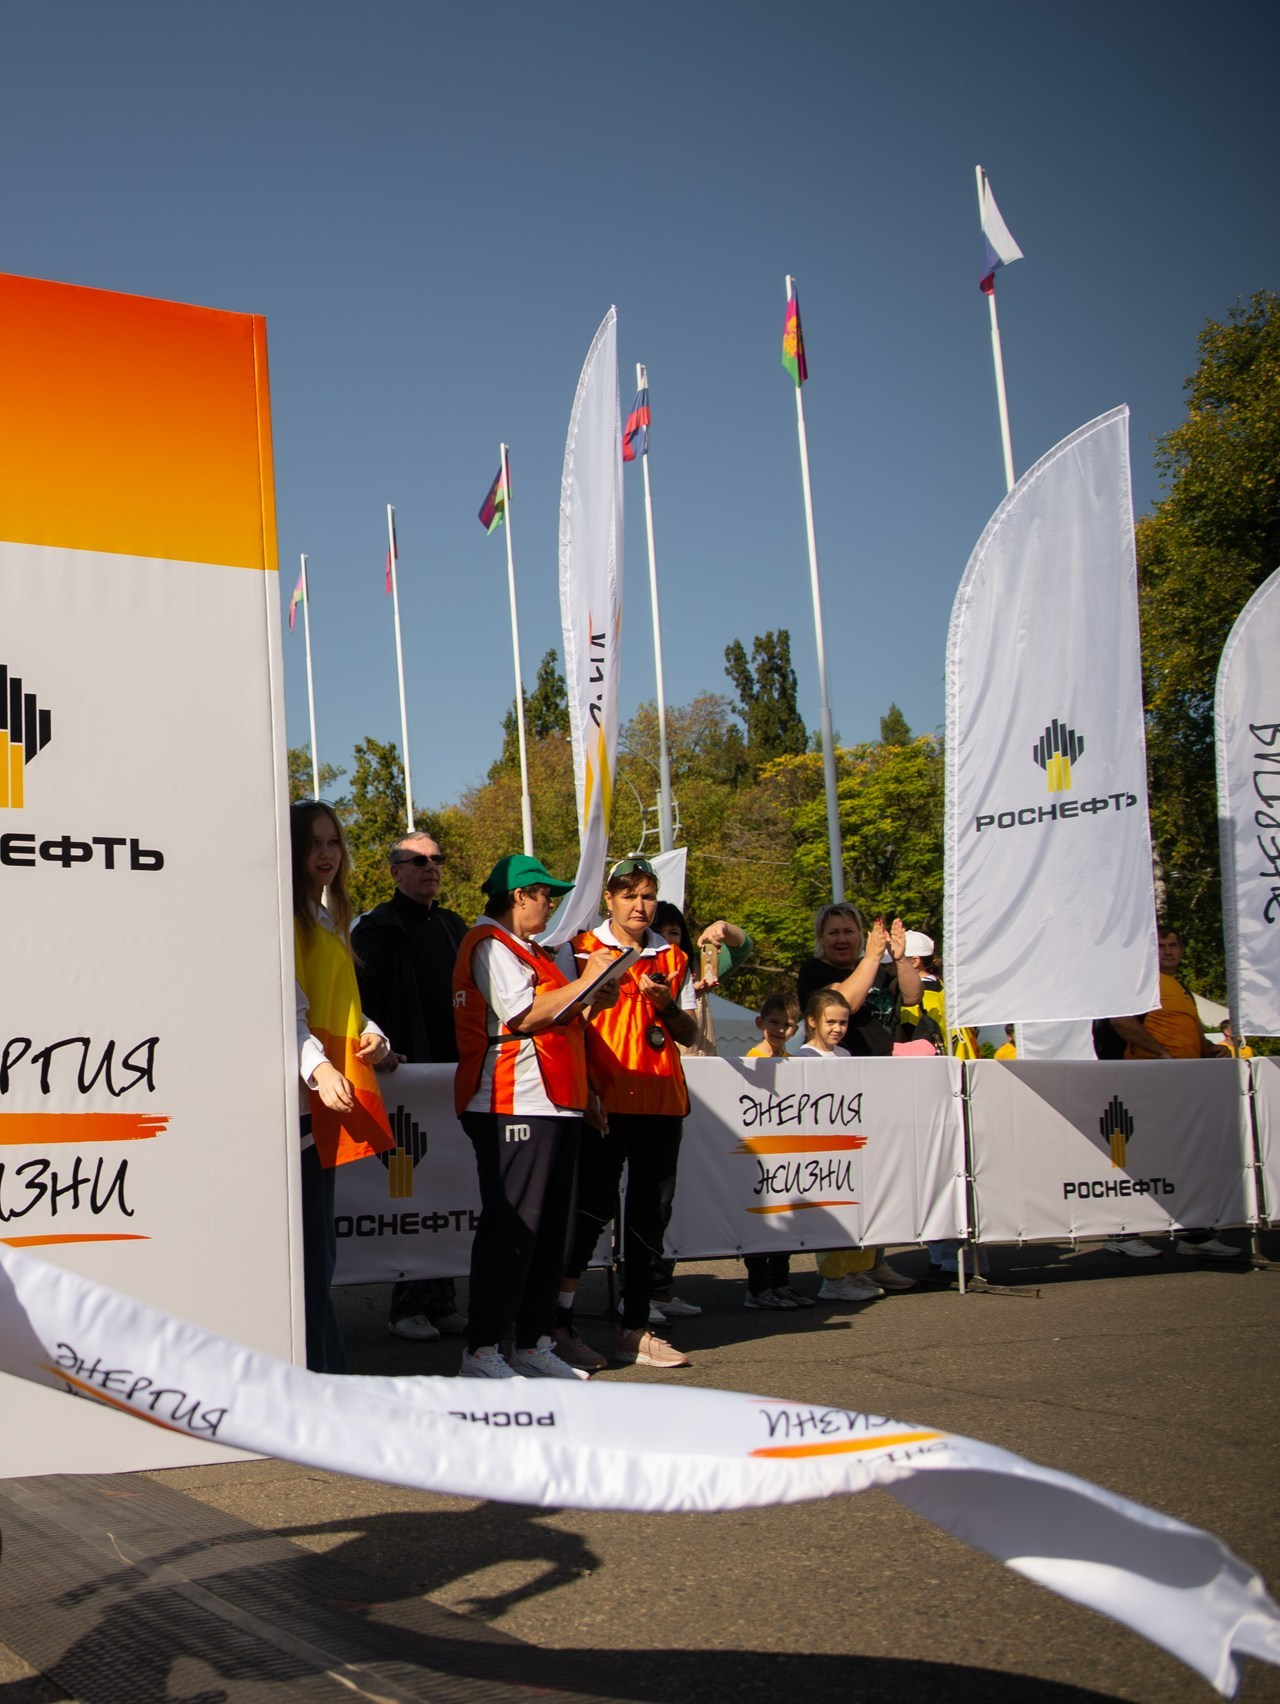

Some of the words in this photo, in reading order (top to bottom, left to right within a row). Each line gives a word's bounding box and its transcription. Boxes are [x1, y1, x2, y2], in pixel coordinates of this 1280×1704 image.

[975, 791, 1138, 832] РОСНЕФТЬ
[739, 1092, 863, 1127] ЭНЕРГИЯ
[505, 1124, 531, 1142] ГТО
[753, 1159, 855, 1195] ЖИЗНИ
[1063, 1178, 1175, 1200] РОСНЕФТЬ
[335, 1210, 481, 1238] ОСНЕФТЬ
[54, 1342, 229, 1438] ЭНЕРГИЯ
[760, 1408, 918, 1438] ИЗНИ
